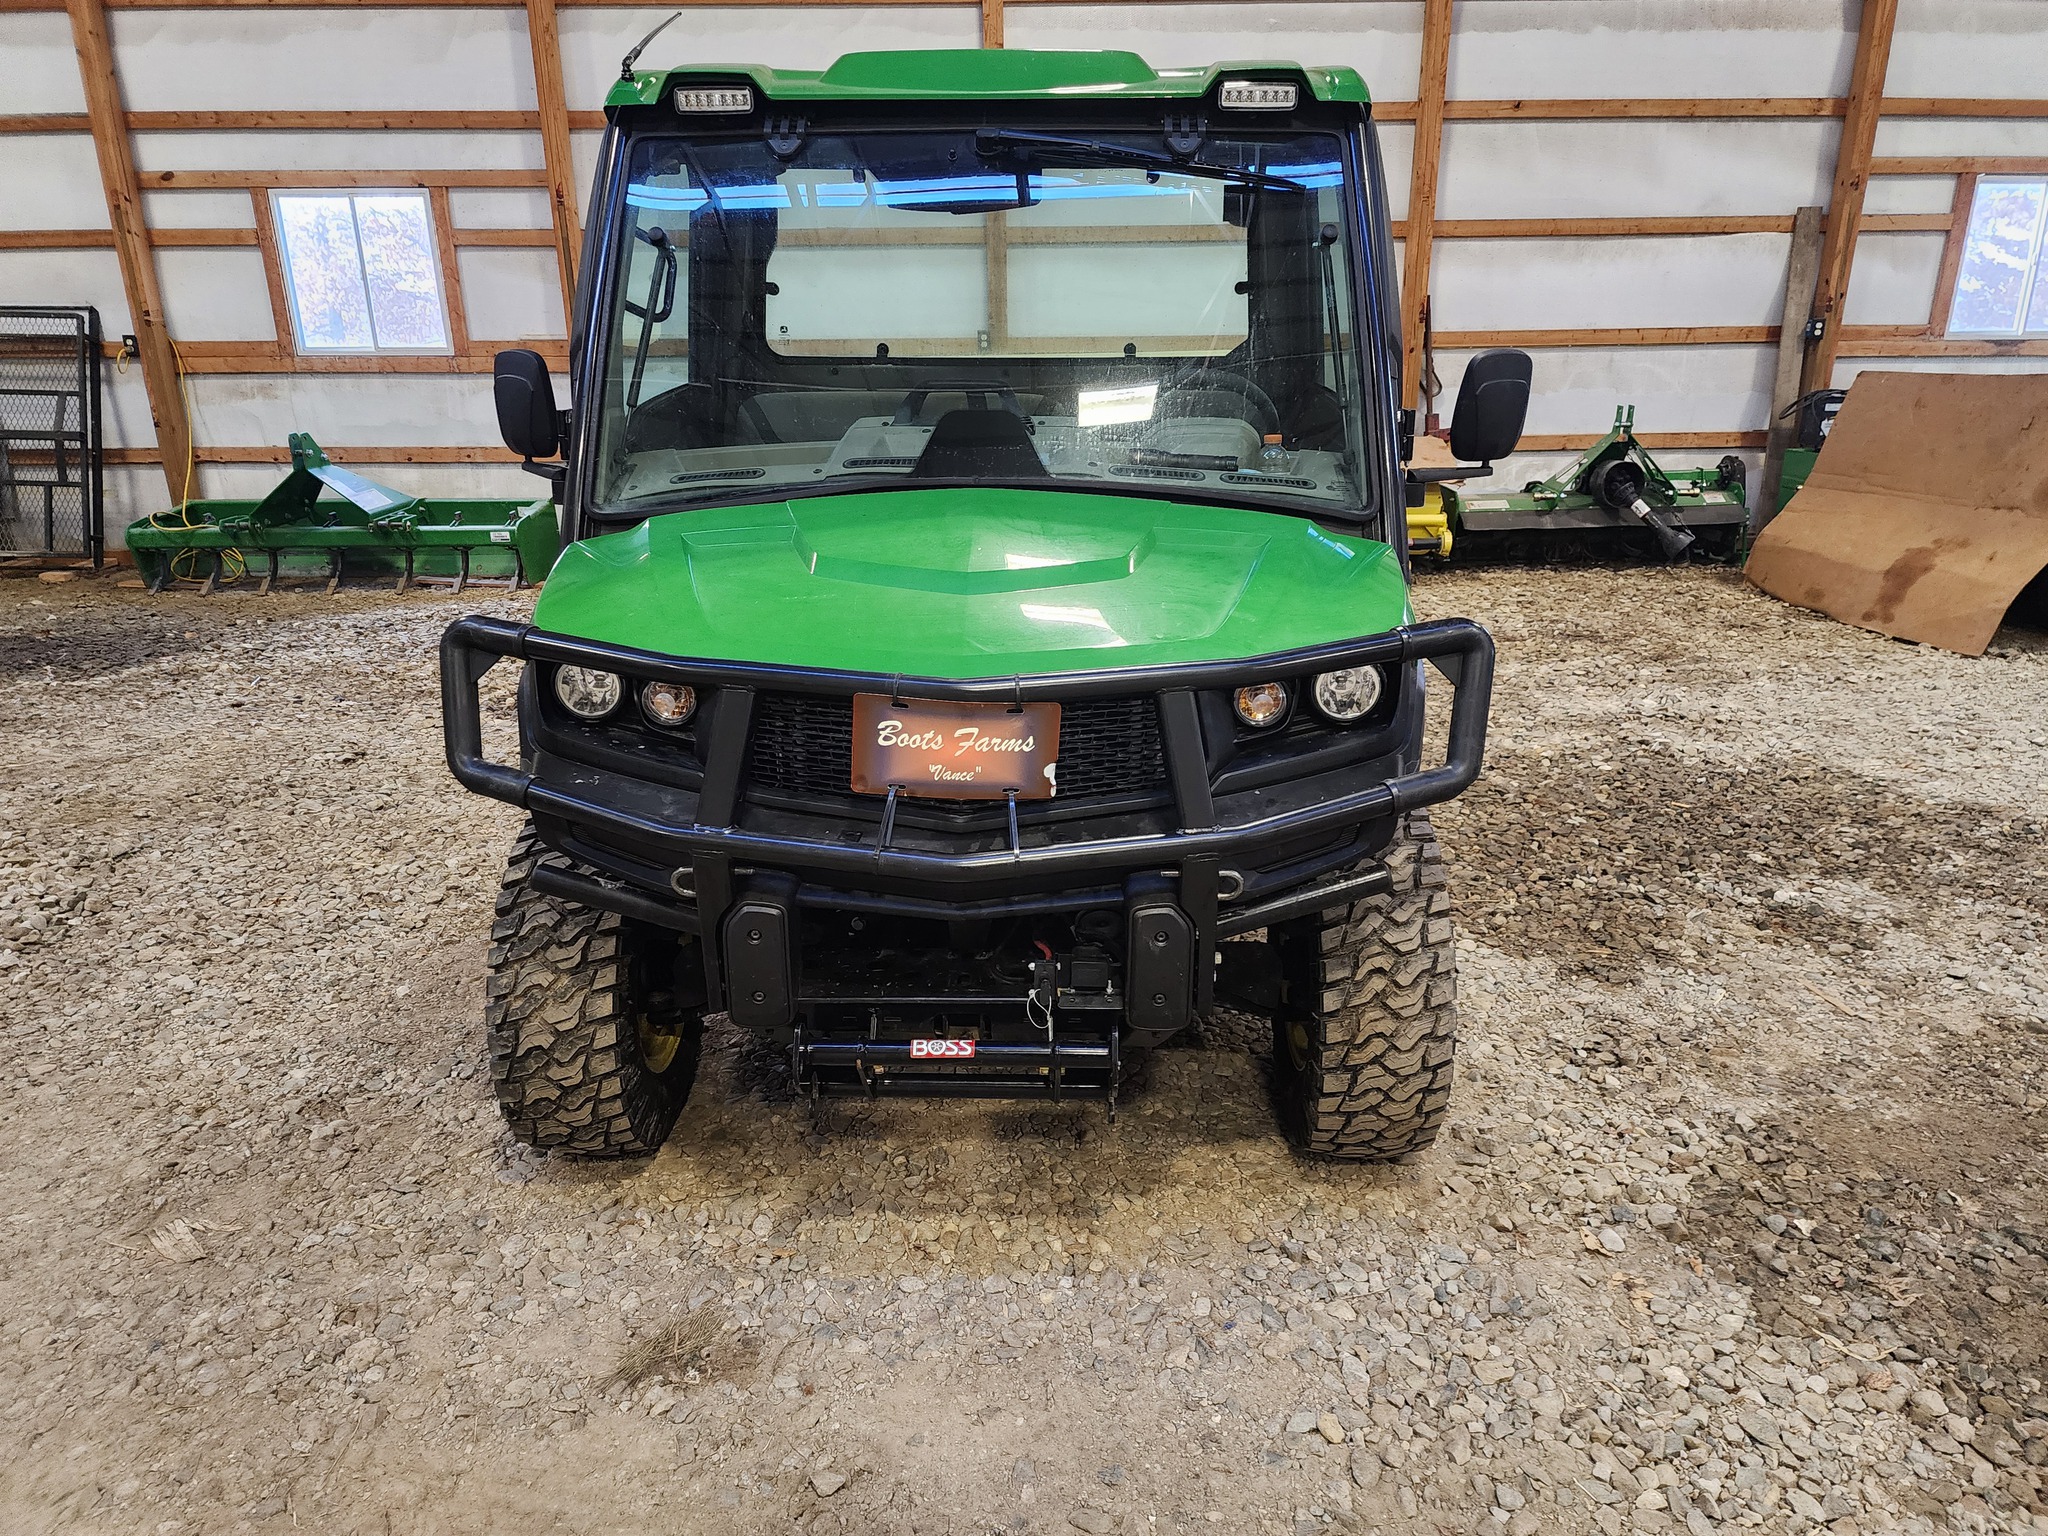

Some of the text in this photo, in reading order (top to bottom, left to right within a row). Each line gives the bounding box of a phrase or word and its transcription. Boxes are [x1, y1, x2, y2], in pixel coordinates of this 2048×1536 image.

[877, 720, 1036, 757] Boots Farms
[929, 764, 982, 781] "Vance"
[912, 1039, 973, 1056] BOSS
